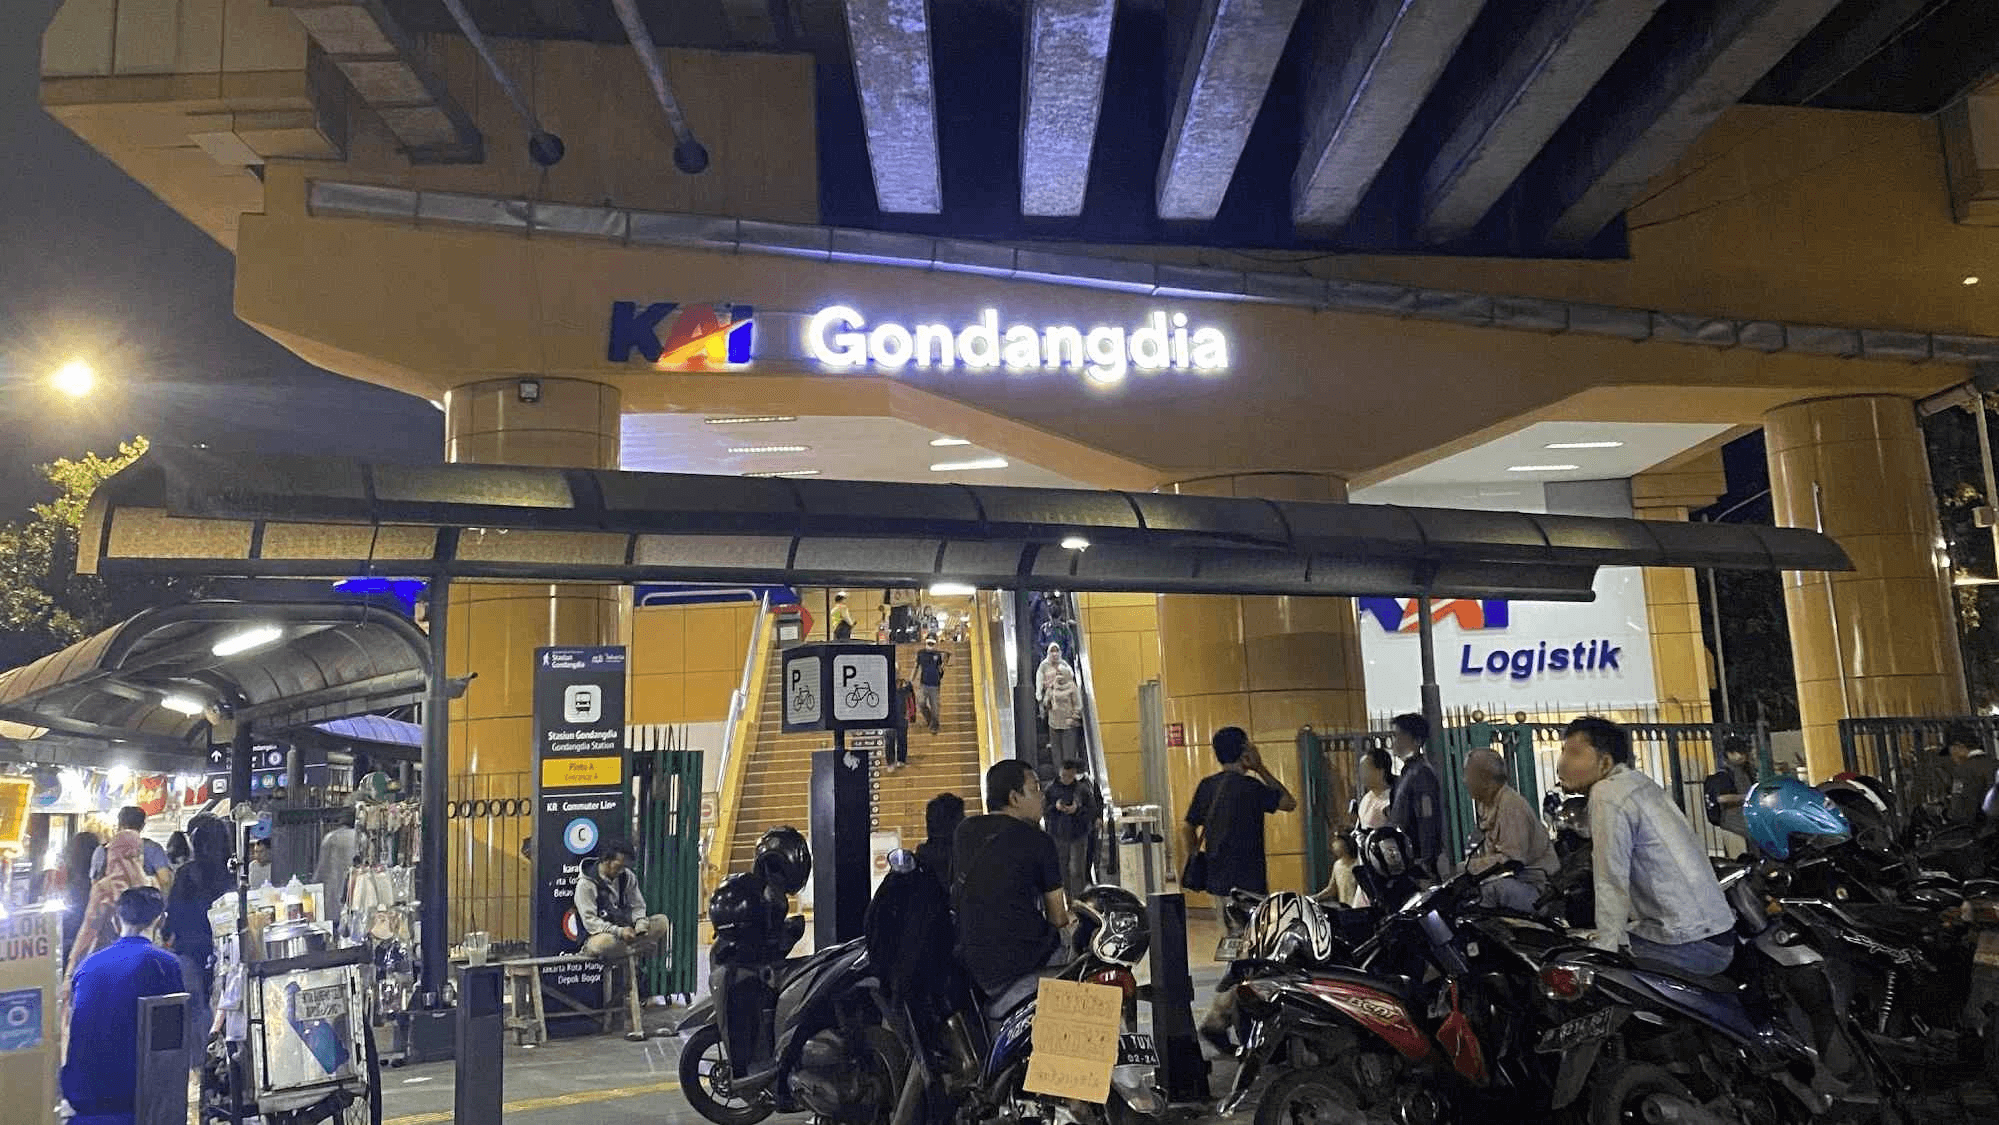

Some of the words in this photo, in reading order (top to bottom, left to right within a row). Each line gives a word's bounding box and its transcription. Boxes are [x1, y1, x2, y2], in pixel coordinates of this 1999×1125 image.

[608, 301, 754, 370] KAI
[807, 305, 1228, 382] Gondangdia
[1459, 640, 1622, 680] Logistik
[792, 669, 801, 691] P
[843, 665, 857, 687] P
[547, 730, 575, 741] Stasiun
[575, 729, 618, 741] Gondangdia
[551, 742, 590, 753] Gondangdia
[591, 740, 615, 750] Station
[562, 801, 600, 812] Commuter
[578, 827, 586, 842] C
